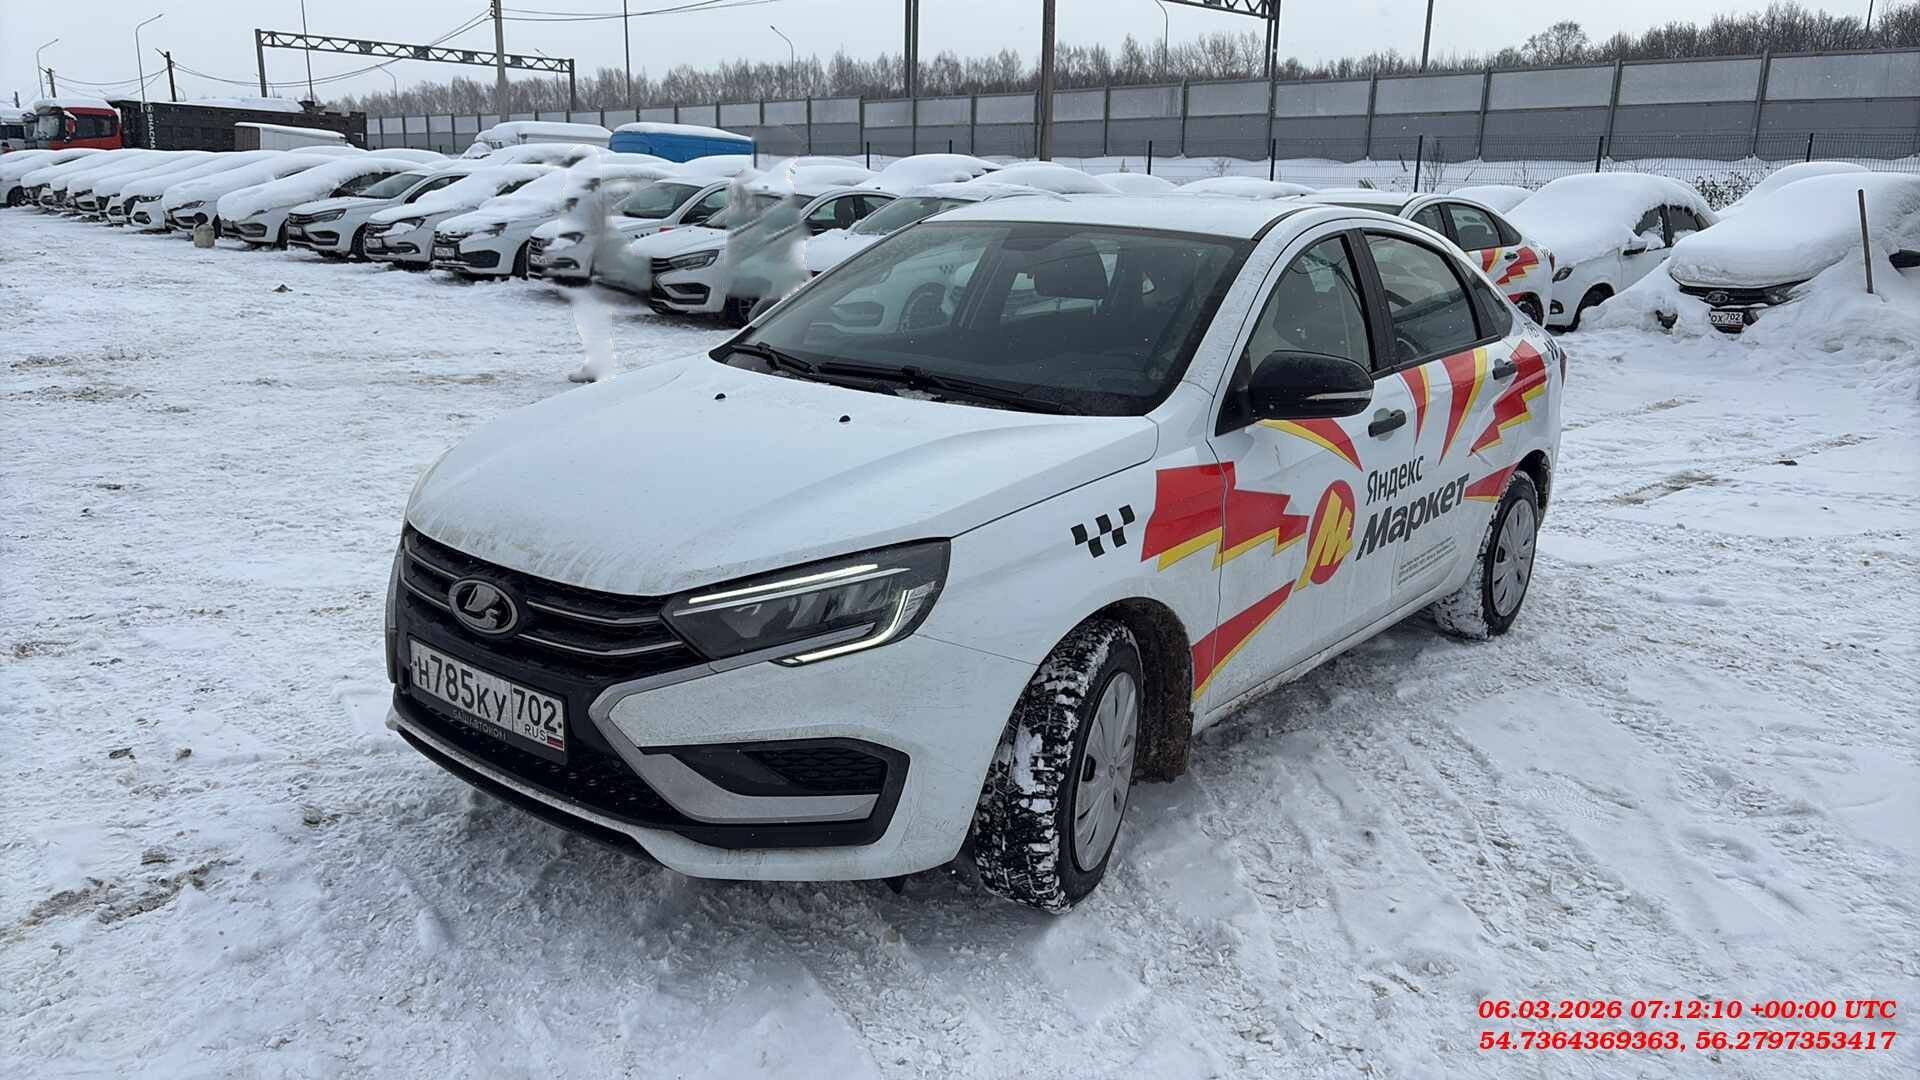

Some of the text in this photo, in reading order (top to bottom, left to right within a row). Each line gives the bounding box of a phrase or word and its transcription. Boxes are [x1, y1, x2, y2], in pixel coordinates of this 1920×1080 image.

[1366, 455, 1424, 506] Яндекс
[1355, 473, 1470, 562] Маркет
[513, 687, 558, 734] 702
[524, 723, 547, 742] RUS
